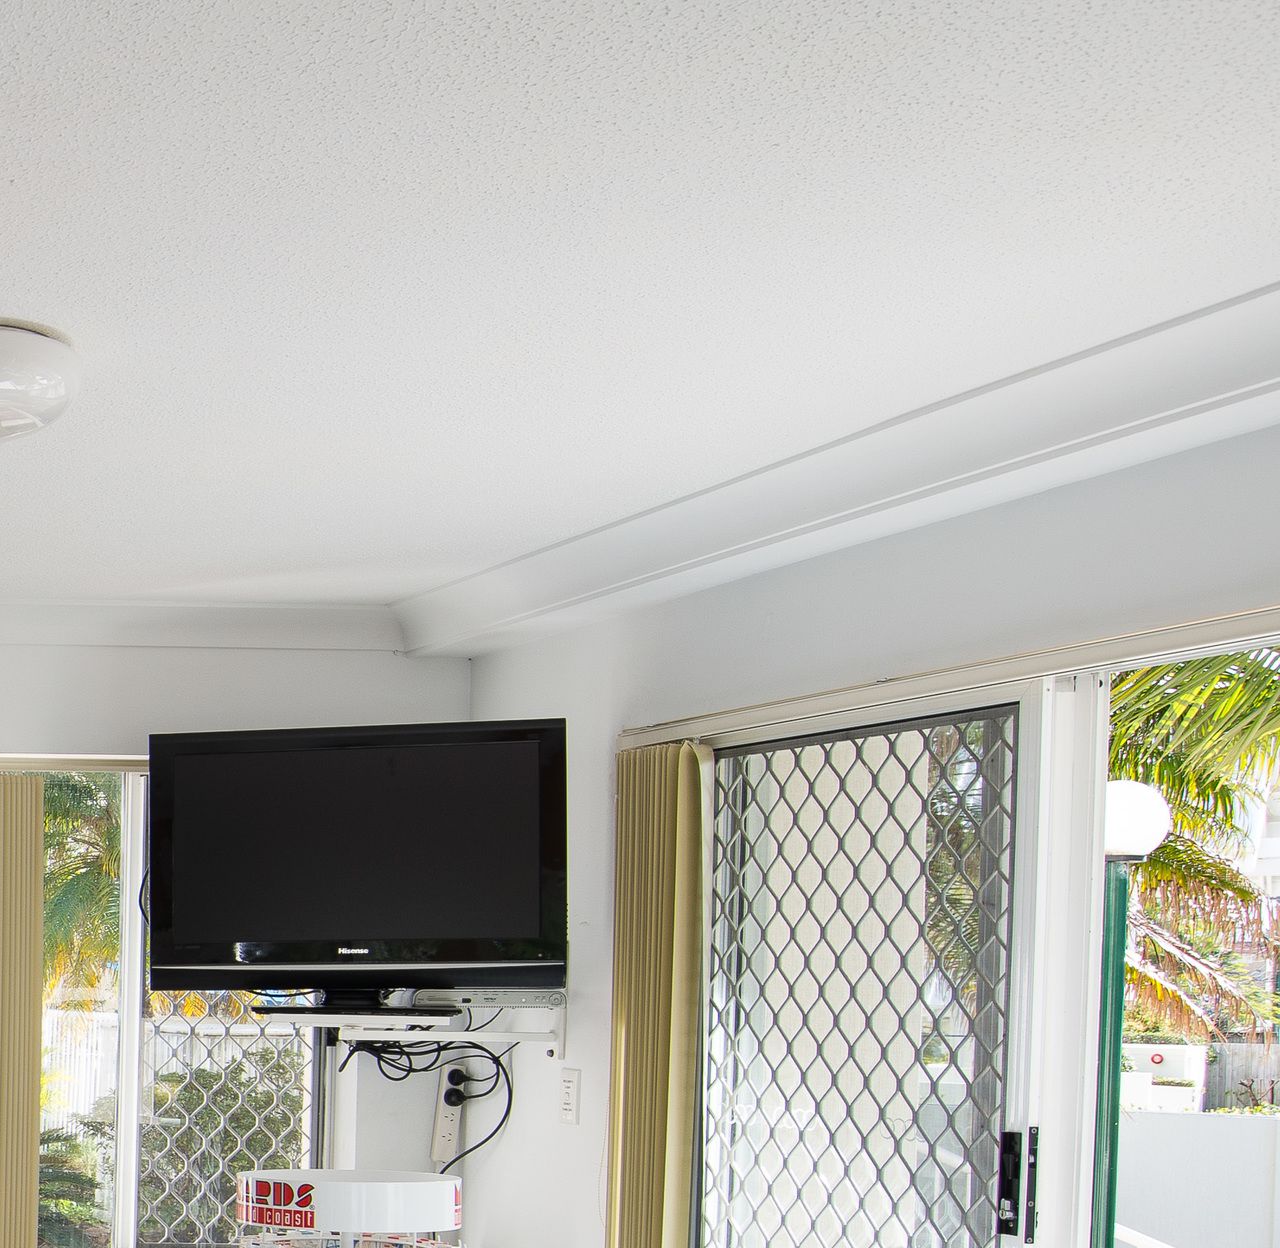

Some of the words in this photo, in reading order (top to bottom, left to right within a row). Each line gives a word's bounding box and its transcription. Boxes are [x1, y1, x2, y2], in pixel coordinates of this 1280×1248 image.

[338, 947, 369, 955] Hisense
[247, 1180, 316, 1208] ARDS
[266, 1210, 314, 1228] coast
